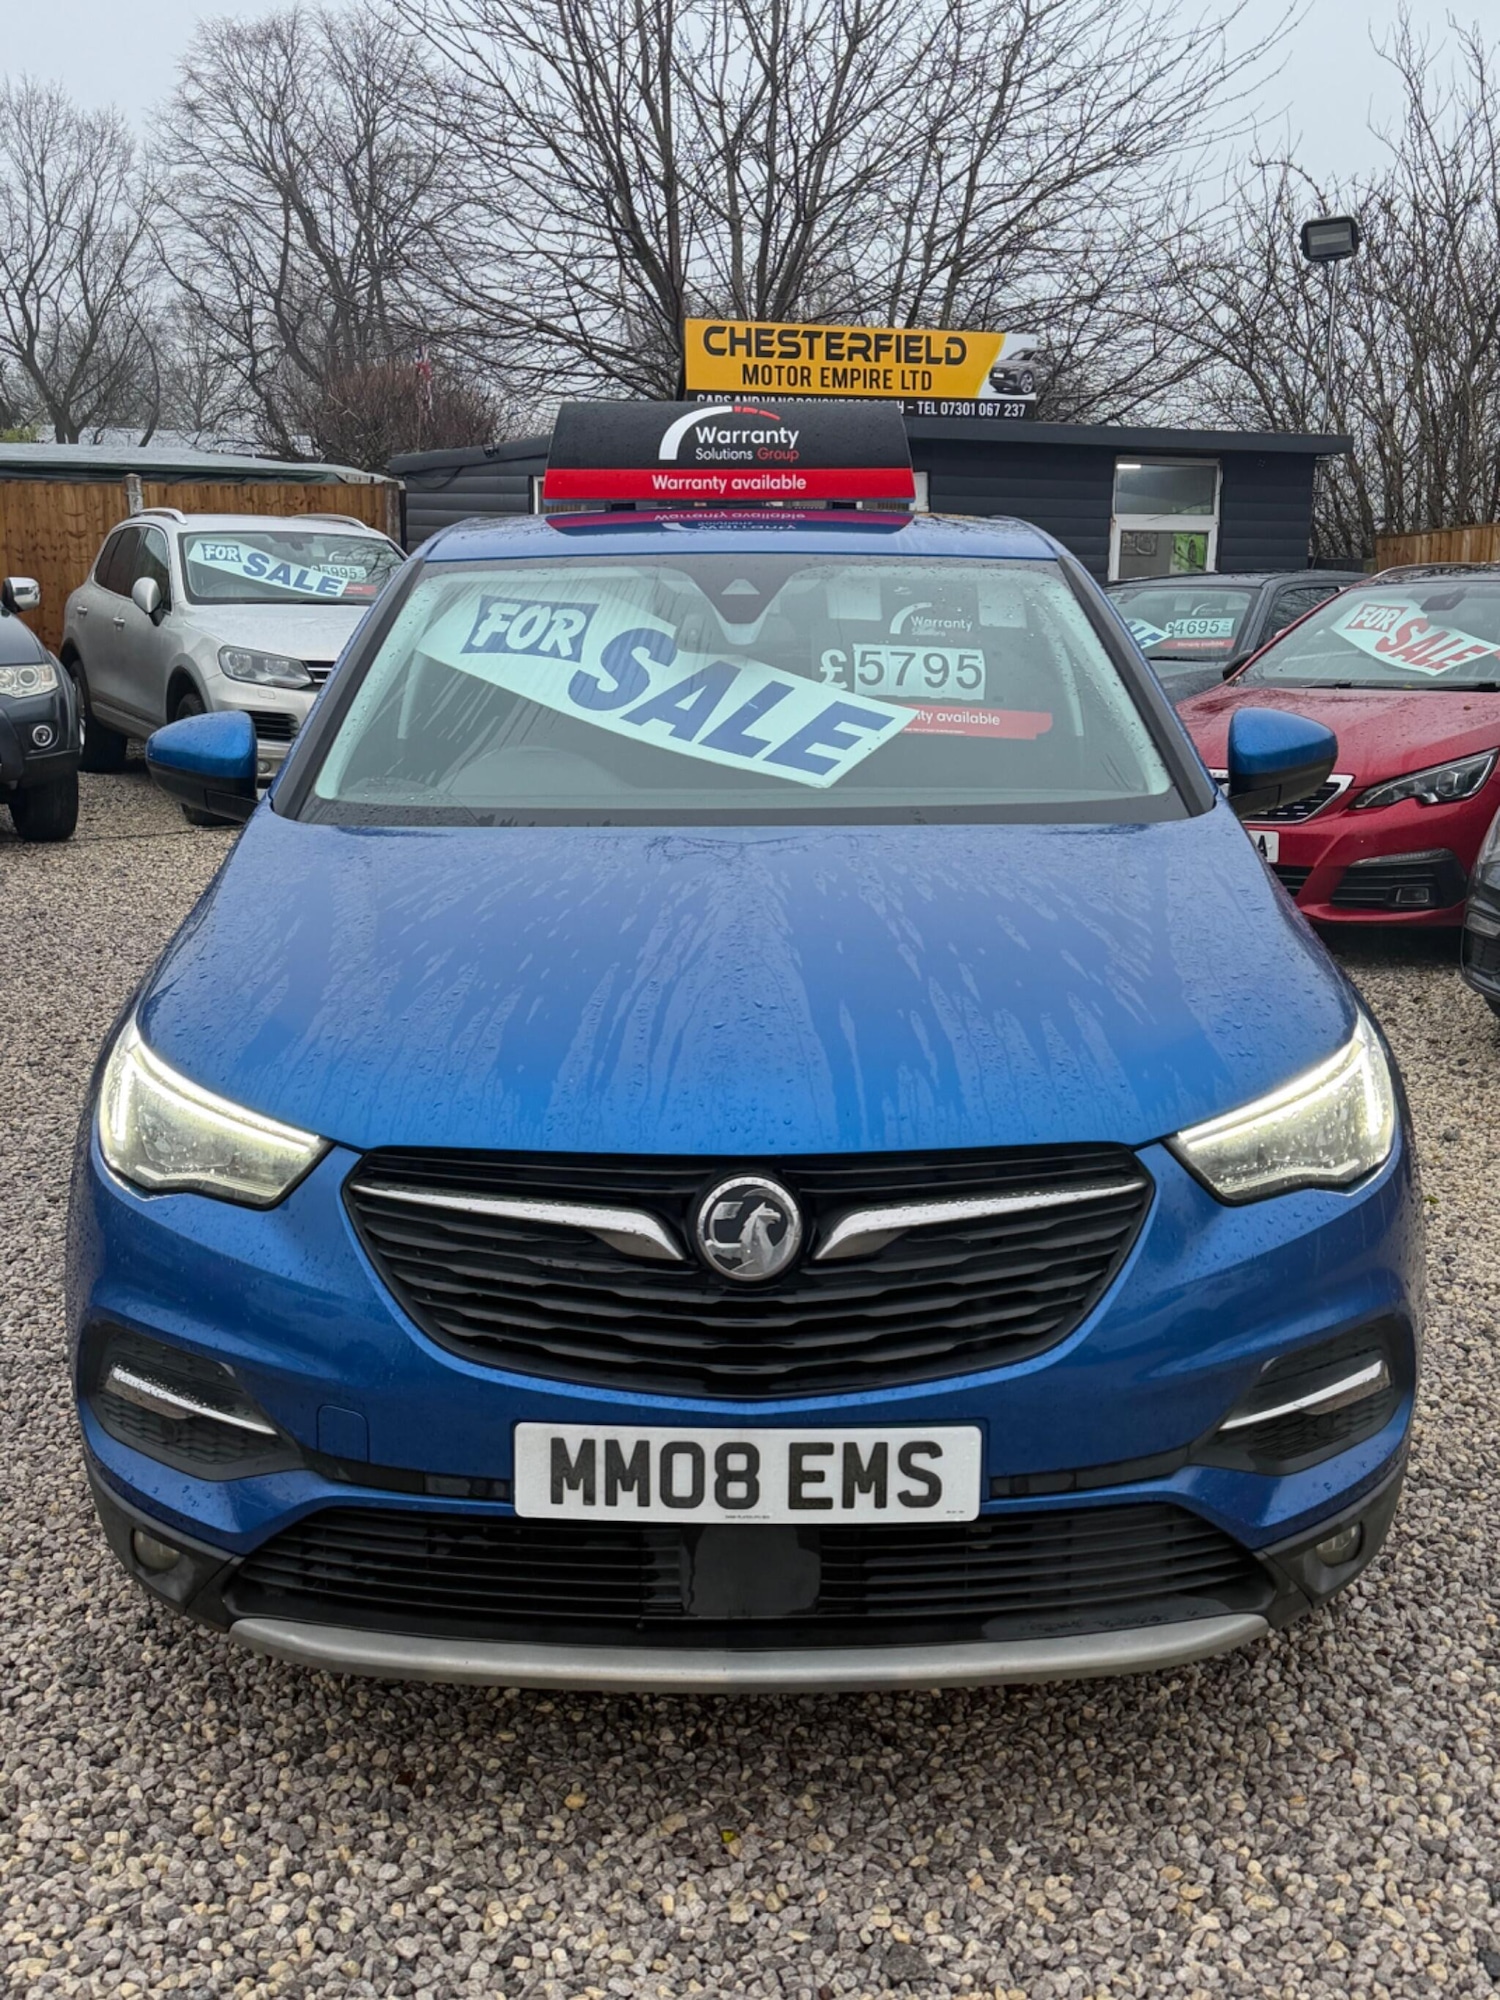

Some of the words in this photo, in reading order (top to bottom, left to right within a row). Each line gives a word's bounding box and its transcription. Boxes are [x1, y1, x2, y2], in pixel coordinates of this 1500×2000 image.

[703, 326, 967, 366] CHESTERFIELD
[742, 363, 812, 388] MOTOR
[820, 367, 893, 390] EMPIRE
[901, 370, 932, 392] LTD
[917, 401, 937, 415] TEL
[940, 401, 975, 416] 07301
[978, 403, 1000, 417] 067
[1004, 403, 1026, 418] 237
[695, 426, 799, 449] Warranty
[695, 447, 753, 461] Solutions
[757, 447, 800, 462] Group
[652, 474, 727, 494] Warranty
[731, 474, 807, 490] available
[204, 544, 241, 562] FOR
[243, 552, 343, 595] SALE
[911, 615, 973, 633] Warranty
[1349, 605, 1401, 631] FOR
[1375, 617, 1491, 671] SALE
[820, 648, 983, 690] £5795
[471, 602, 586, 659] FOR
[567, 628, 896, 776] SALE
[937, 710, 1000, 726] available
[550, 1437, 760, 1509] MM08
[788, 1441, 943, 1508] EMS
